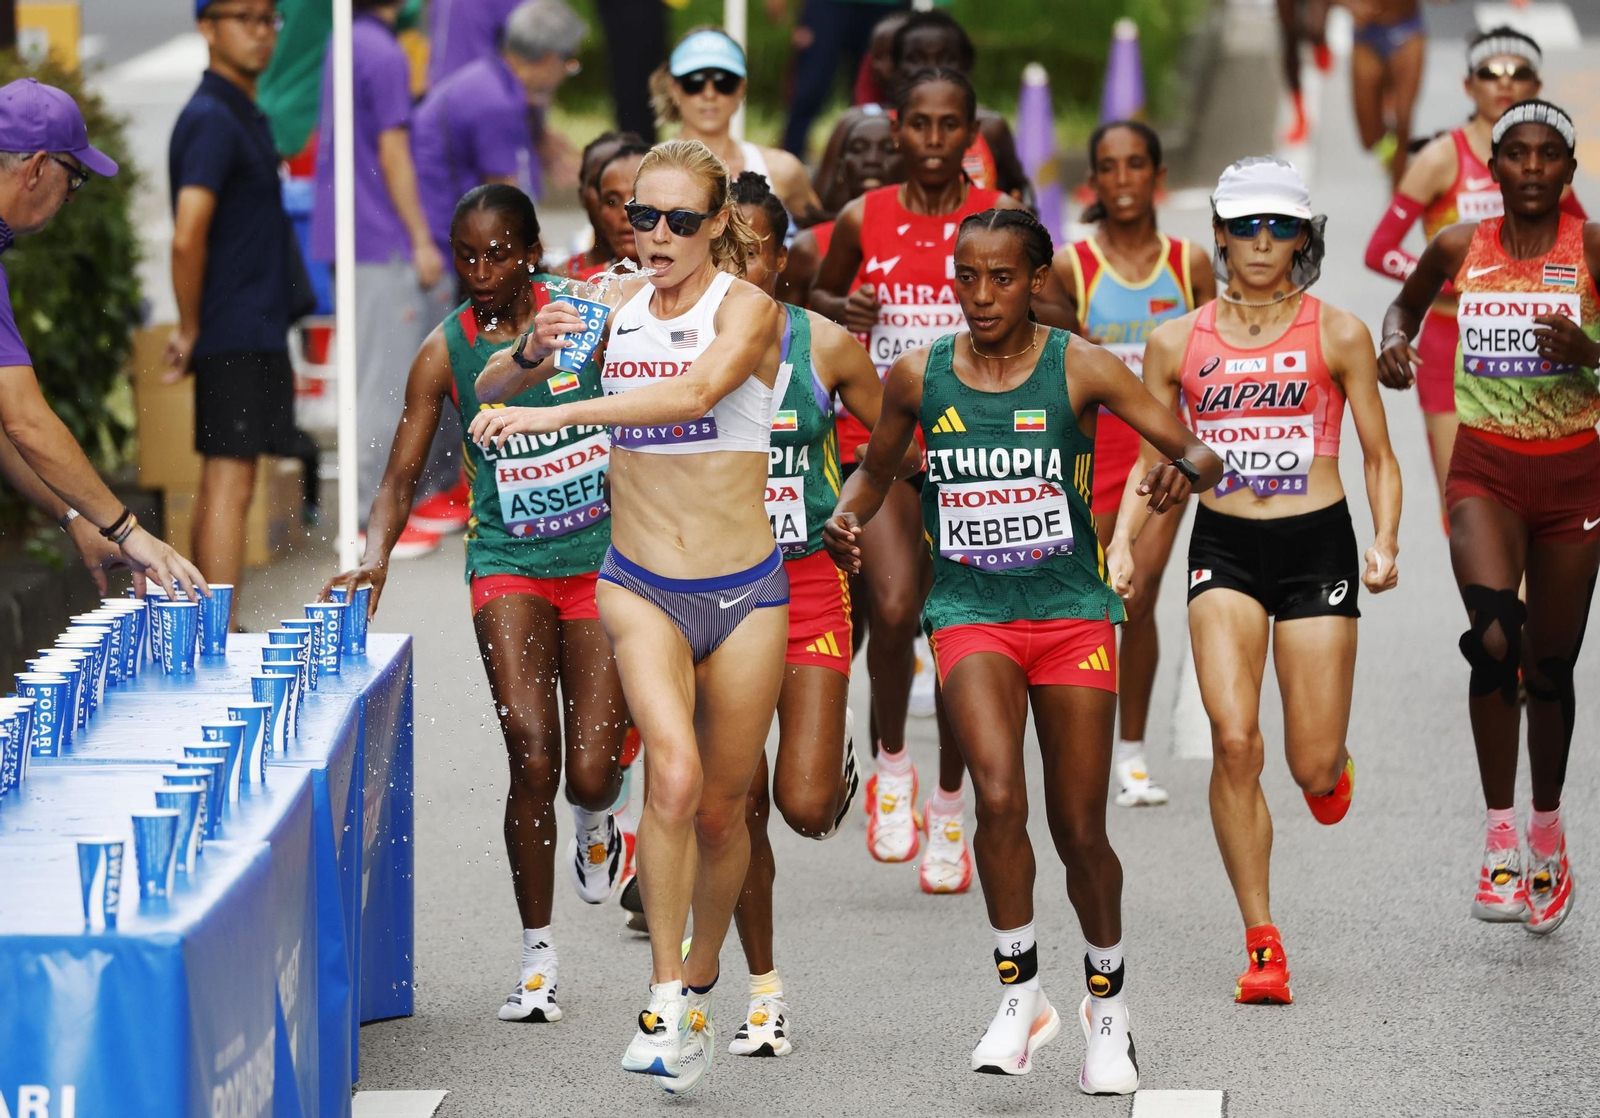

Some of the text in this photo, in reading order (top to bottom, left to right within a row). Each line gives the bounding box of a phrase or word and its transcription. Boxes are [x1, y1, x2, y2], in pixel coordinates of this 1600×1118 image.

[1461, 302, 1576, 317] HONDA
[564, 303, 588, 360] SEAT
[572, 306, 603, 370] POCARI
[1466, 328, 1538, 352] CHERO
[1196, 381, 1308, 414] JAPAN
[688, 422, 711, 436] 25
[1201, 425, 1310, 444] HONDA
[499, 444, 609, 482] HONDA
[927, 447, 1063, 483] ETHIOPIA
[510, 470, 607, 519] ASSEFA
[939, 484, 1063, 508] HONDA
[1282, 479, 1303, 490] 25
[948, 510, 1063, 546] KEBEDE
[110, 619, 121, 675] SWEAT
[327, 610, 338, 672] POCARI
[40, 687, 52, 754] POCARI
